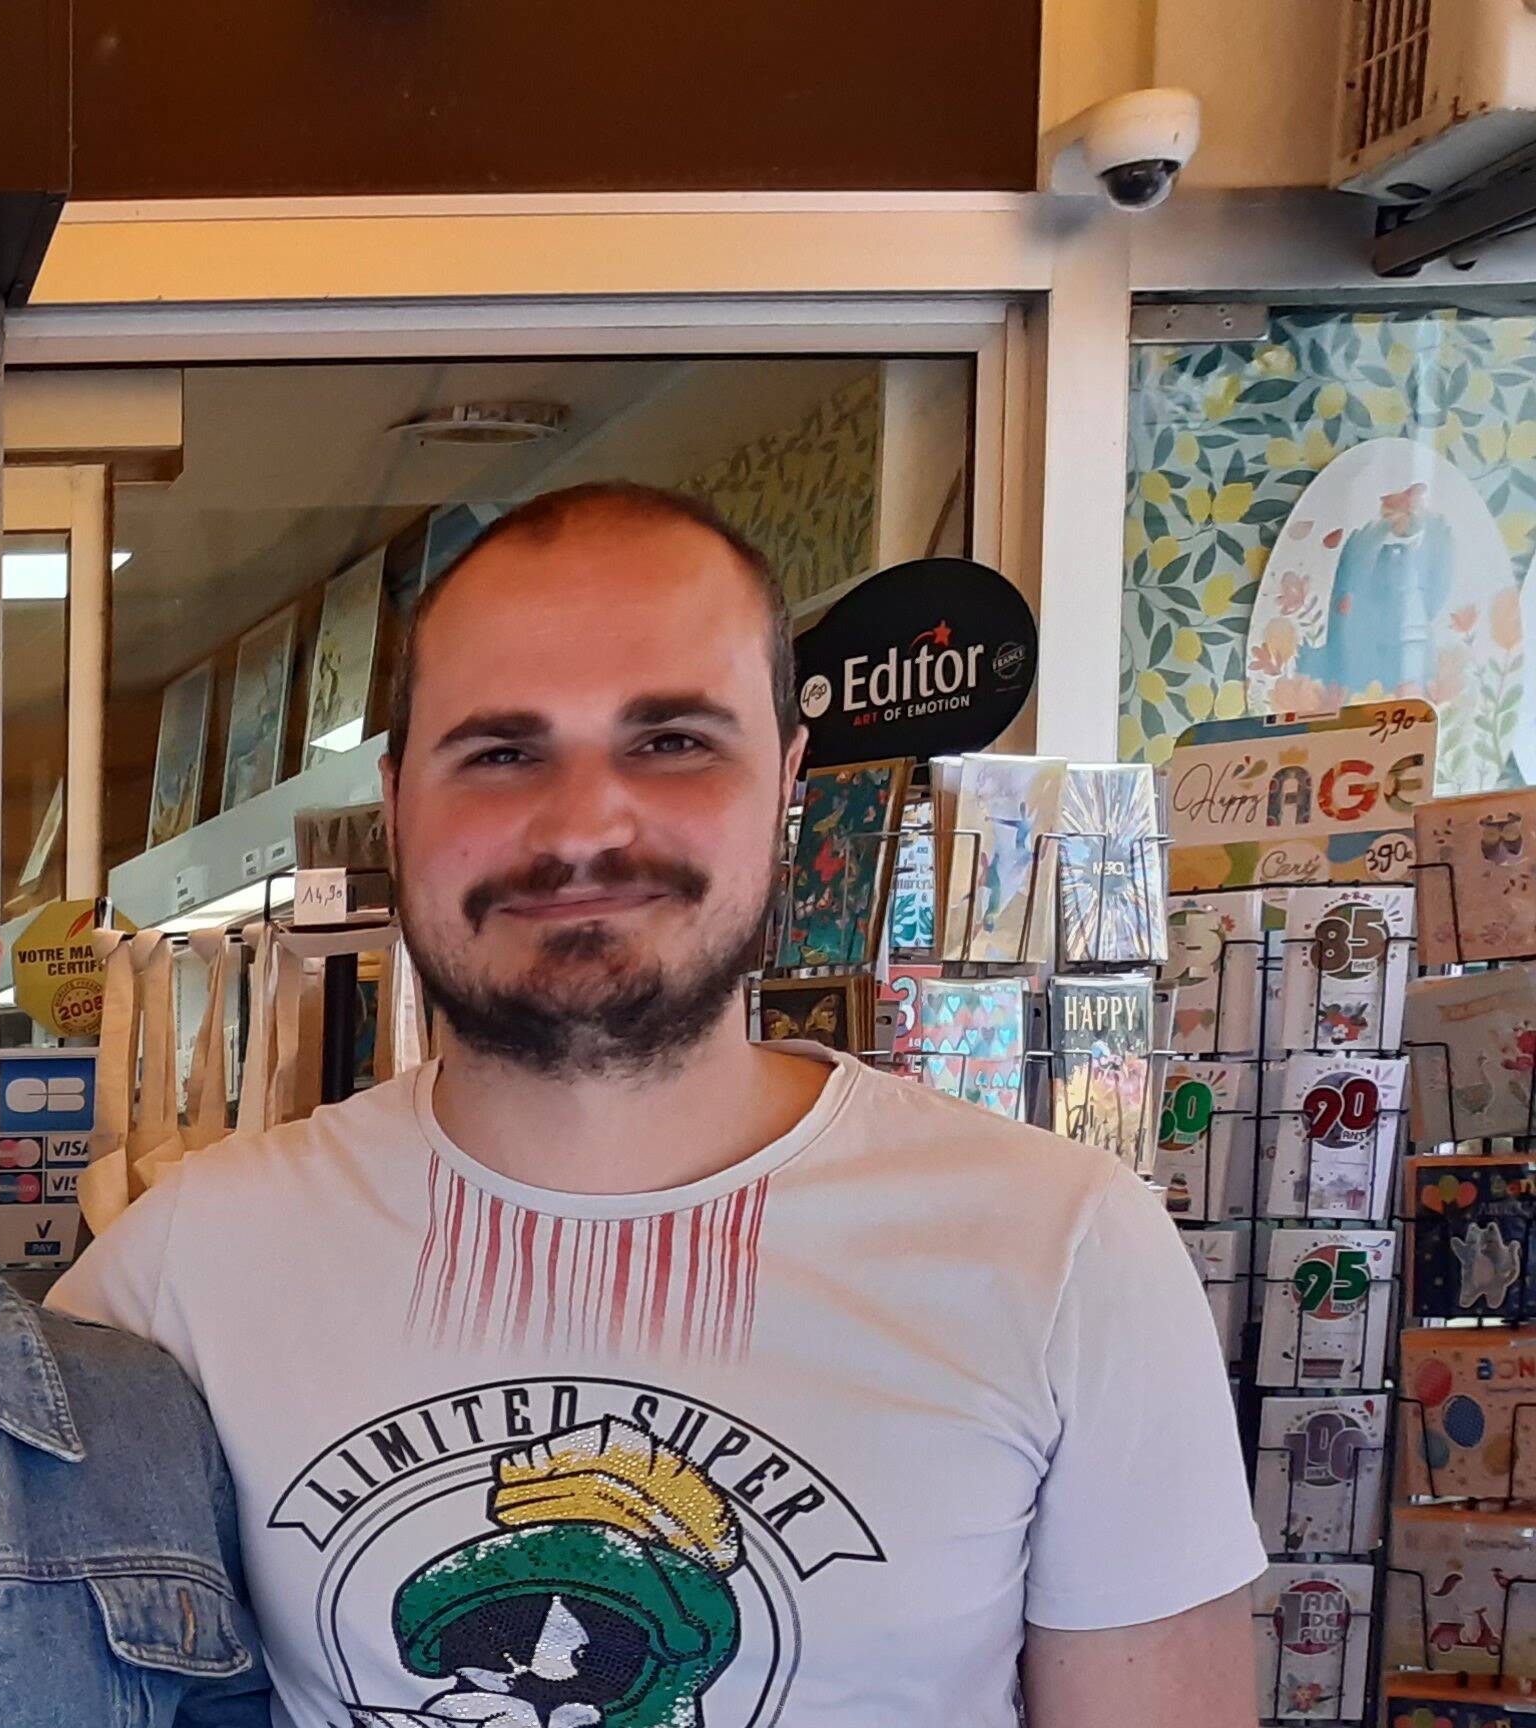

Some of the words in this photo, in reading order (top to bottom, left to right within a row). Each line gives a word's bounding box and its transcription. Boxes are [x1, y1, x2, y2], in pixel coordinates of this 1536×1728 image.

[843, 644, 984, 712] Editor
[853, 712, 877, 726] ART
[884, 708, 901, 722] OF
[907, 696, 969, 718] EMOTION
[301, 884, 344, 906] 14,90
[18, 948, 63, 964] VOTRE
[1311, 907, 1389, 973] 85
[1064, 996, 1136, 1031] HAPPY
[5, 1078, 85, 1113] CB
[1304, 1078, 1380, 1140] 90
[1294, 1250, 1370, 1311] 95
[307, 1385, 578, 1514] LIMITED
[632, 1395, 827, 1533] SUPER
